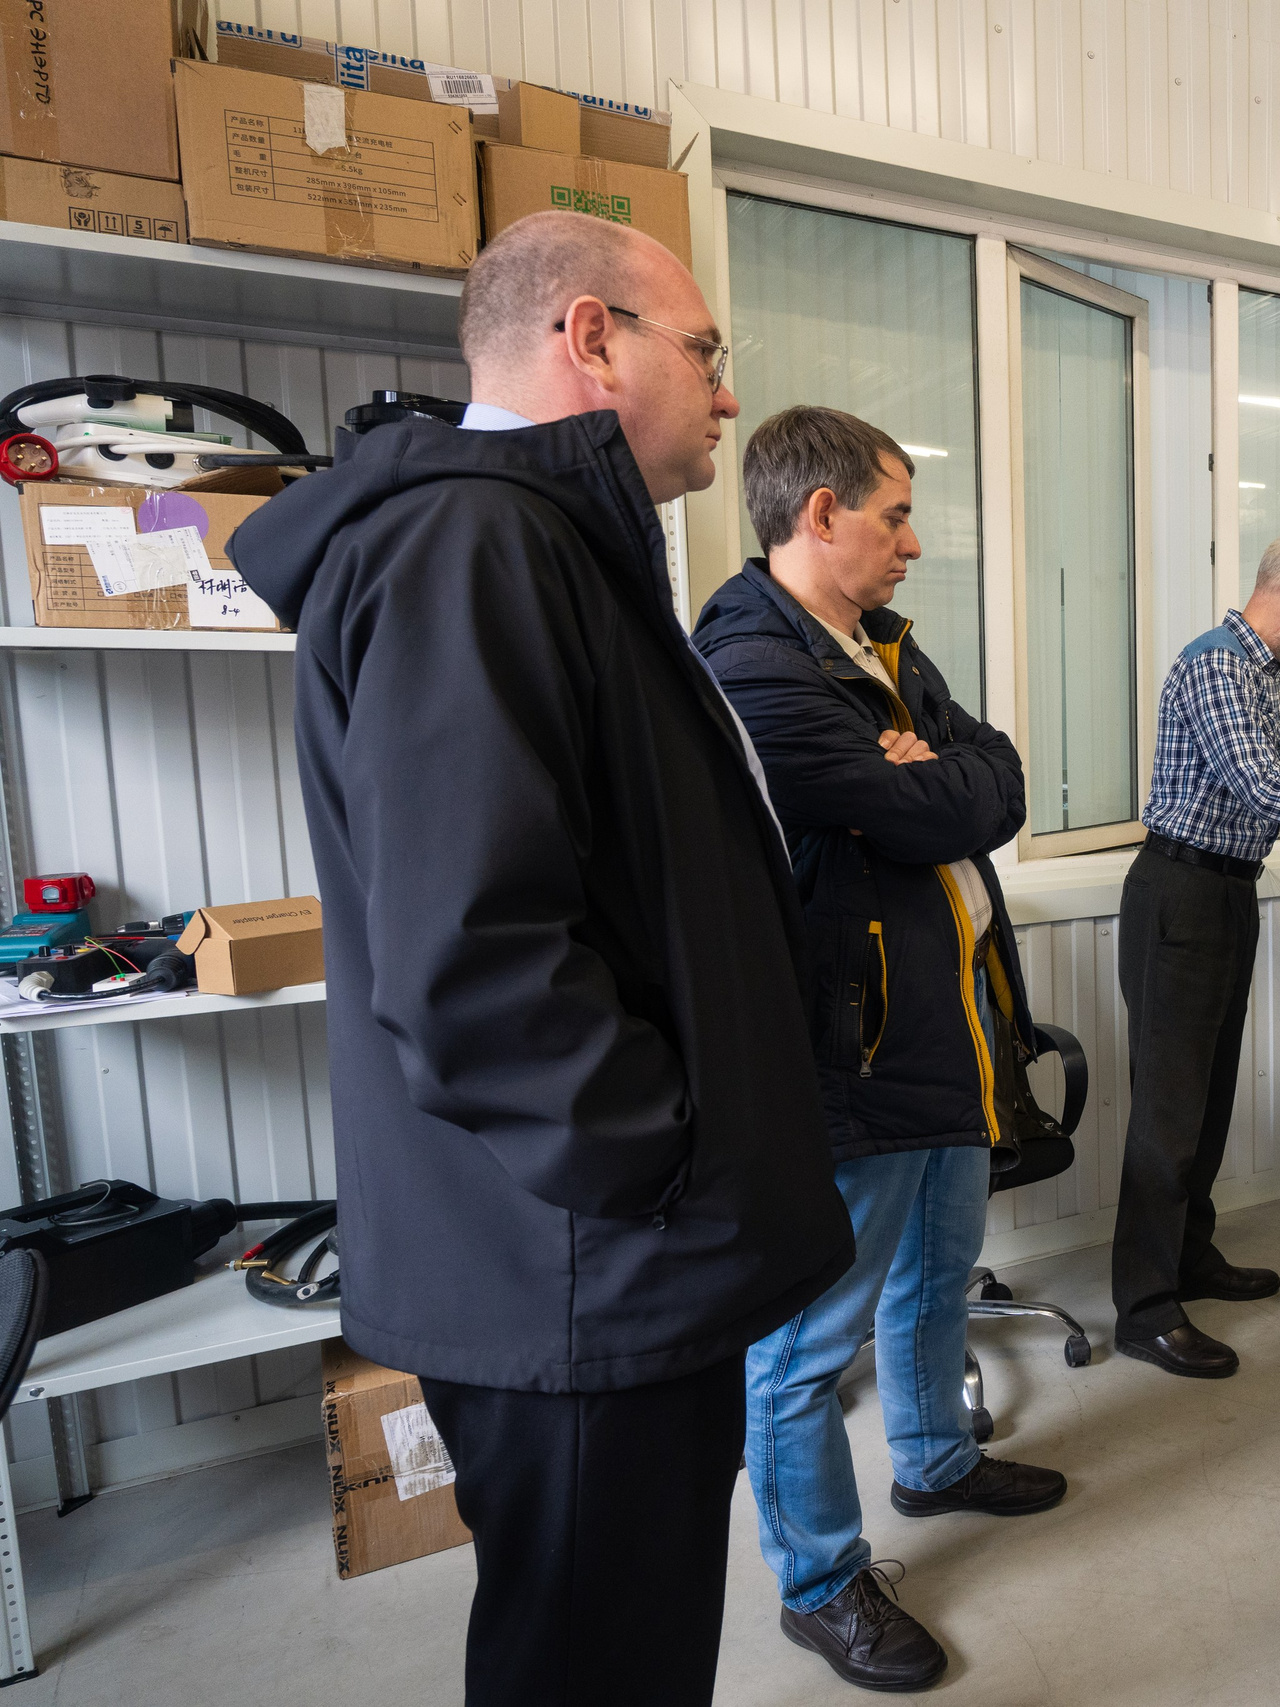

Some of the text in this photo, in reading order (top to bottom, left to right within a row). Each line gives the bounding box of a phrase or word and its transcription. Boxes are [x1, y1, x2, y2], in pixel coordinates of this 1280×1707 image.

[230, 116, 264, 128] 产品名称
[232, 133, 265, 145] 产品数量
[235, 166, 267, 178] 整机尺寸
[341, 165, 363, 175] 5.5kg
[236, 183, 269, 195] 包装尺寸
[306, 177, 336, 187] 285mm
[378, 187, 406, 197] 105mm
[307, 193, 337, 204] 522mm
[379, 203, 407, 213] 235mm
[232, 916, 264, 925] Adapter
[266, 911, 298, 920] Charger
[325, 1403, 341, 1455] NUX
[337, 1525, 350, 1578] NUX
